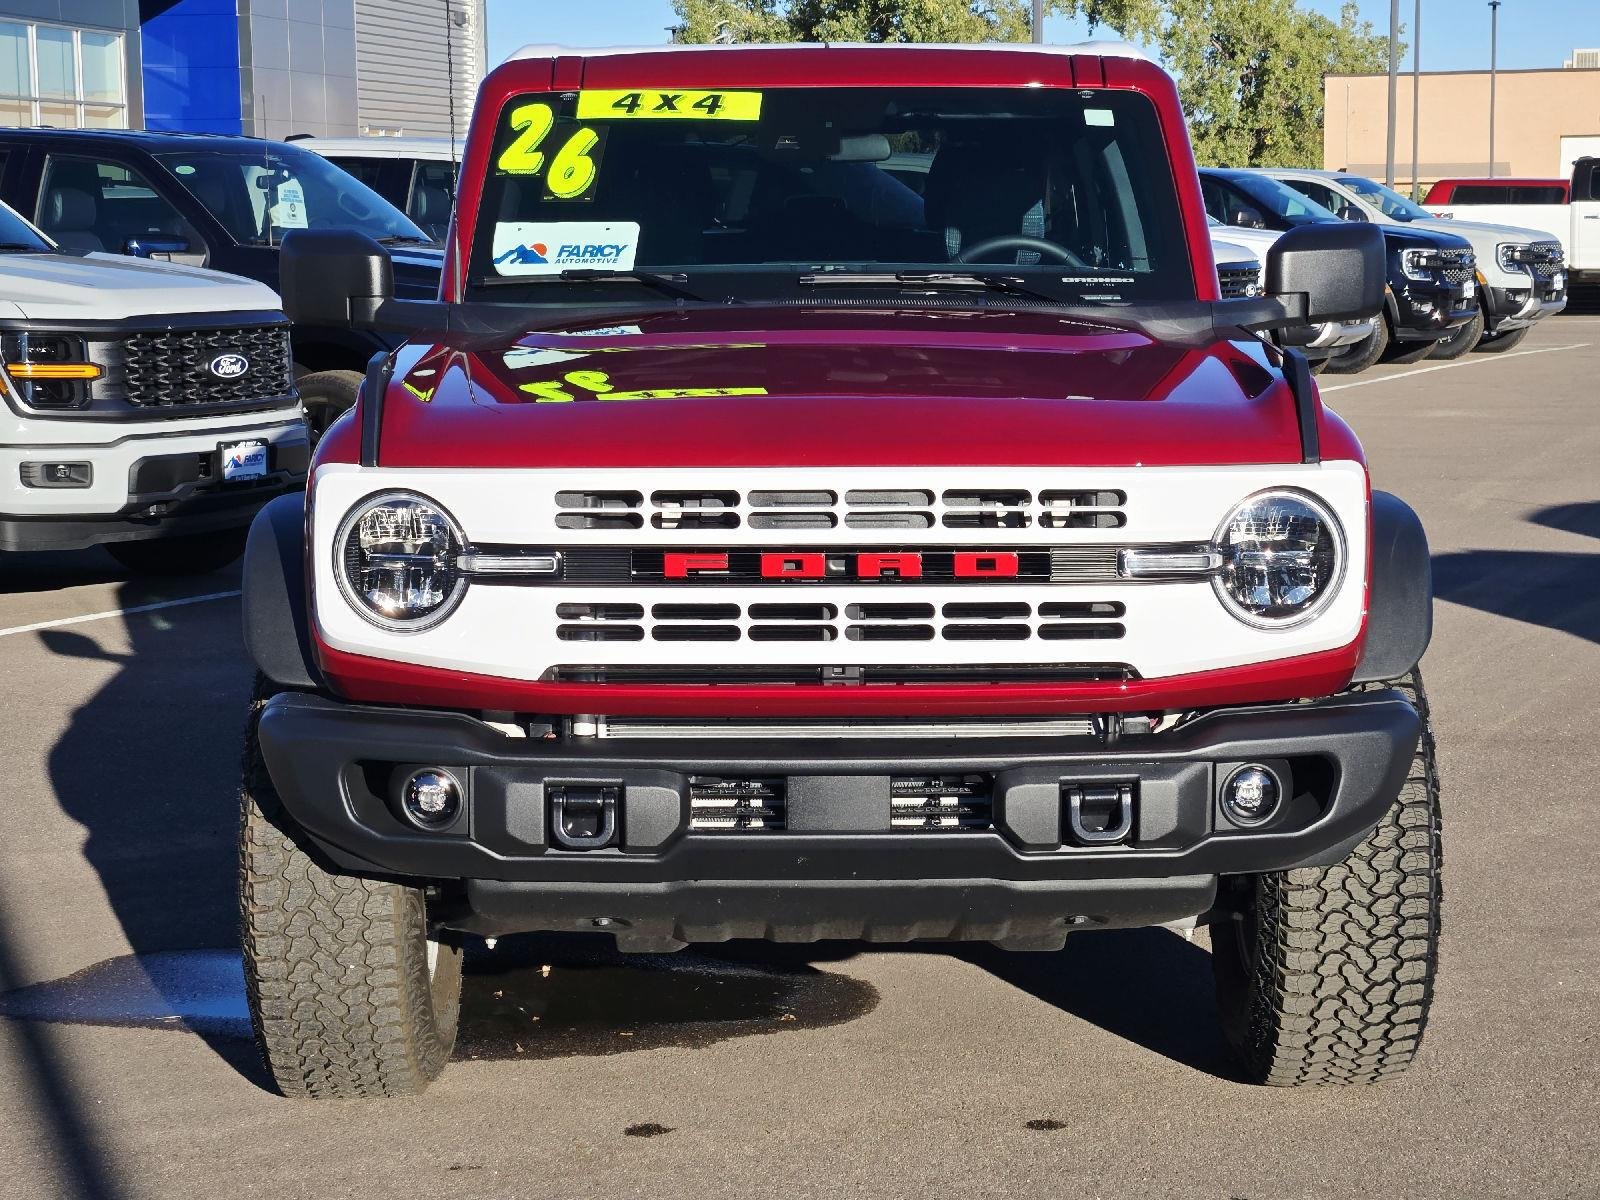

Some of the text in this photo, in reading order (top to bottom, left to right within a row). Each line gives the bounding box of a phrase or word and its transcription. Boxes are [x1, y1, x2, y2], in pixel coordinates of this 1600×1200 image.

[557, 244, 628, 257] FARICY
[218, 357, 242, 374] Ford
[664, 552, 1019, 578] FORD
